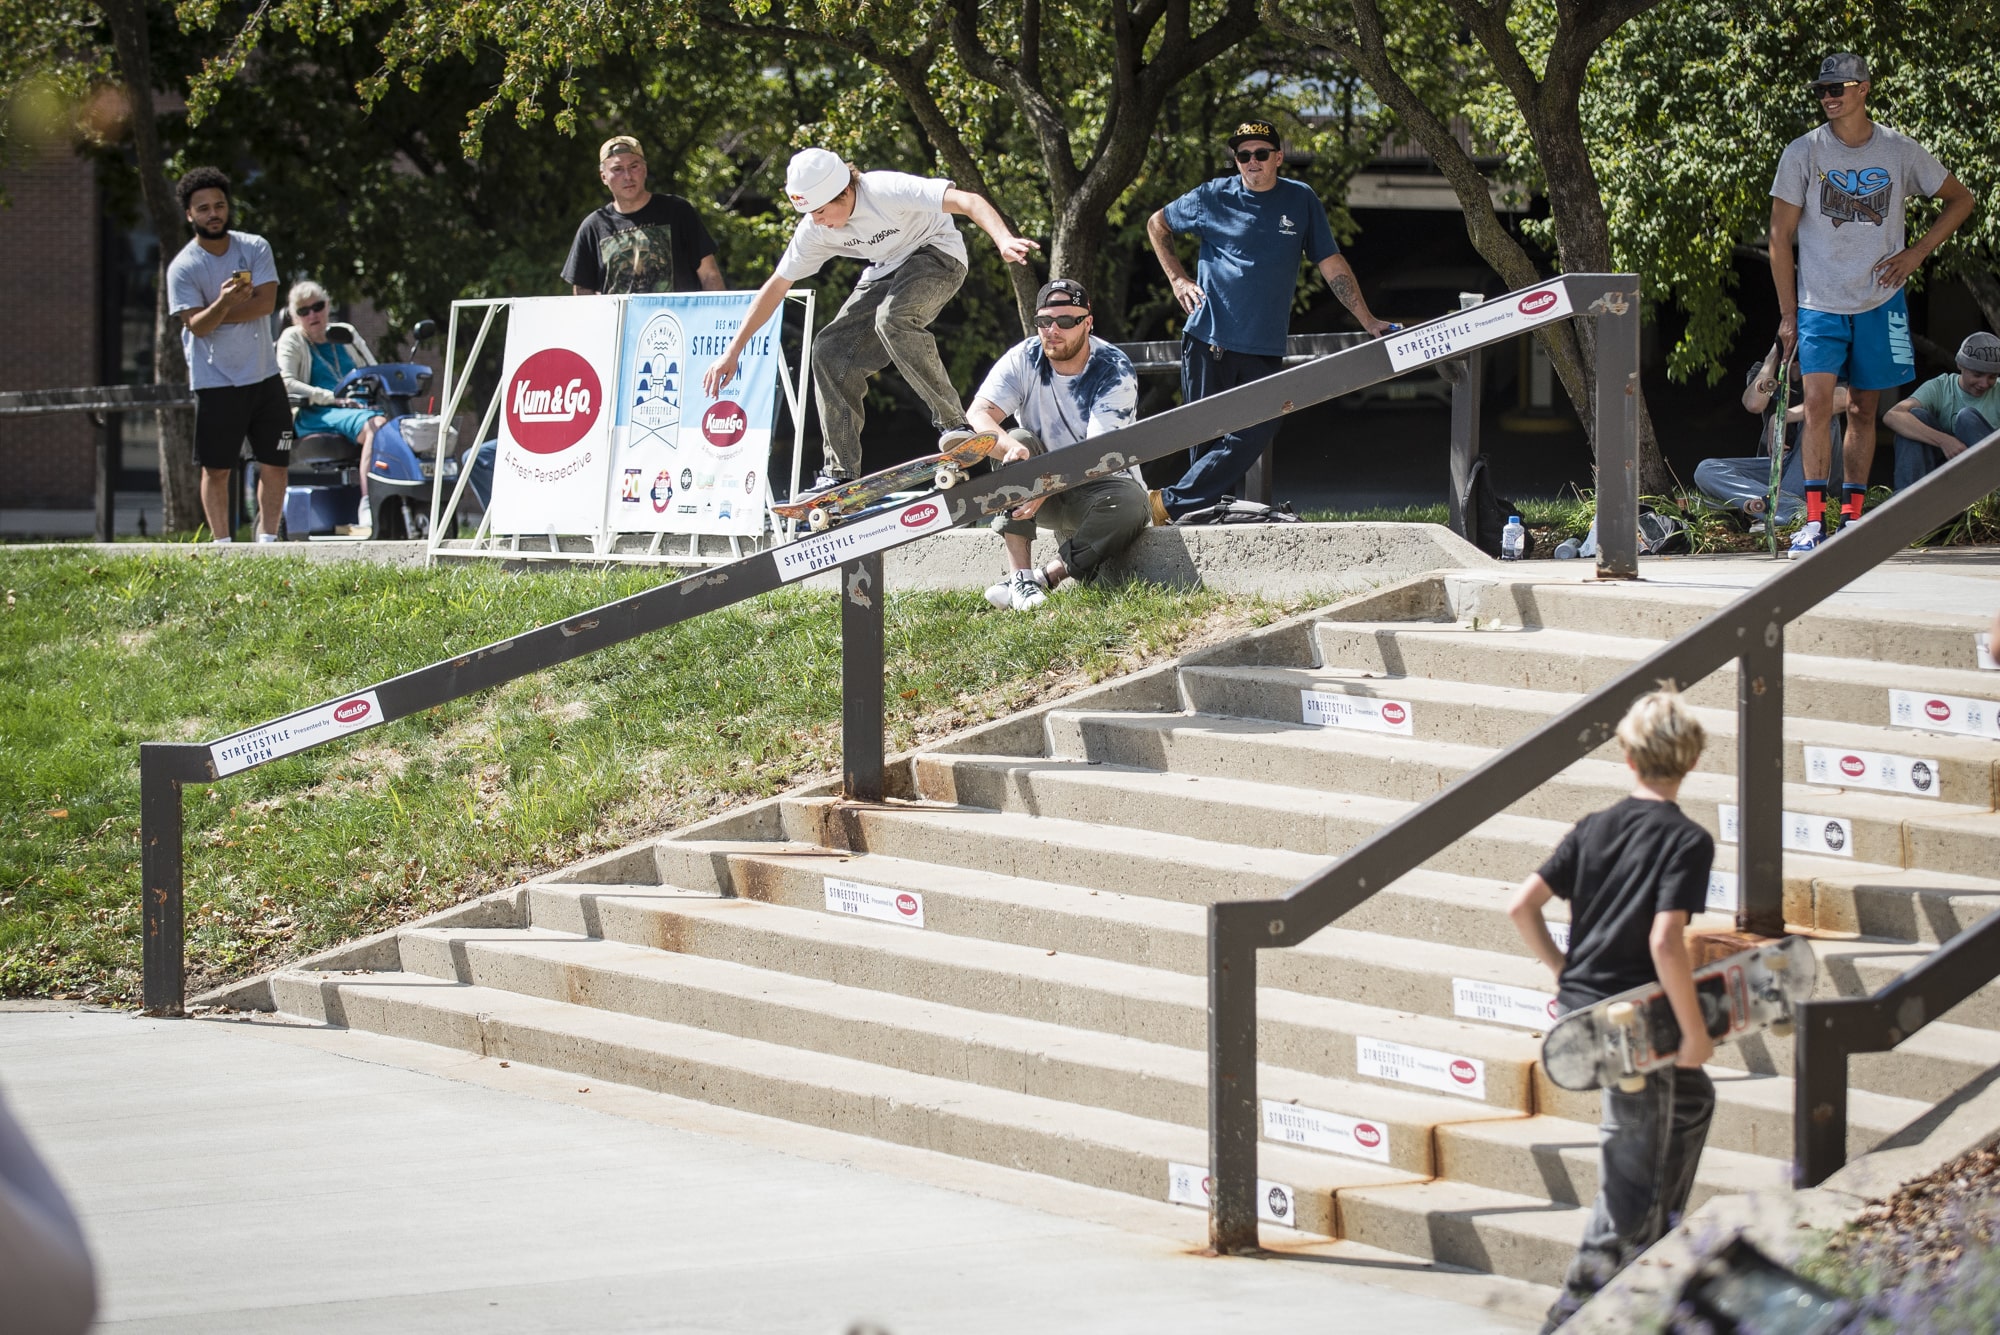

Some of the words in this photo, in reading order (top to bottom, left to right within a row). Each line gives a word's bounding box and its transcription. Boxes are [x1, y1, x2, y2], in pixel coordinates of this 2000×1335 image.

[1236, 123, 1270, 136] Coors
[715, 320, 727, 330] DES
[1475, 314, 1505, 328] Presented
[1506, 311, 1514, 320] by
[1398, 322, 1471, 356] STREETSTYLE
[1888, 311, 1915, 365] NIKE
[1424, 344, 1451, 360] OPEN
[504, 450, 510, 462] A
[511, 457, 533, 480] Fresh
[534, 451, 592, 486] Perspective
[858, 526, 888, 540] Presented
[888, 523, 897, 532] by
[801, 540, 812, 548] DES
[812, 534, 832, 545] MOINES
[784, 534, 856, 567] STREETSTYLE
[810, 554, 837, 570] OPEN
[1307, 700, 1352, 715] STREETSTYLE
[1322, 714, 1339, 724] OPEN
[293, 721, 322, 736] Presented
[322, 719, 330, 728] by
[238, 735, 248, 743] DES
[248, 729, 268, 740] MOINES
[221, 730, 290, 761] STREETSTYLE
[246, 748, 273, 765] OPEN
[829, 888, 870, 904] STREETSTYLE
[842, 902, 858, 913] OPEN
[1460, 990, 1512, 1008] STREETSTYLE
[1477, 1006, 1496, 1019] OPEN
[1362, 1048, 1415, 1068] STREETSTYLE
[1380, 1064, 1399, 1078] OPEN
[1268, 1112, 1320, 1132] STREETSTYLE
[1285, 1128, 1305, 1142] OPEN
